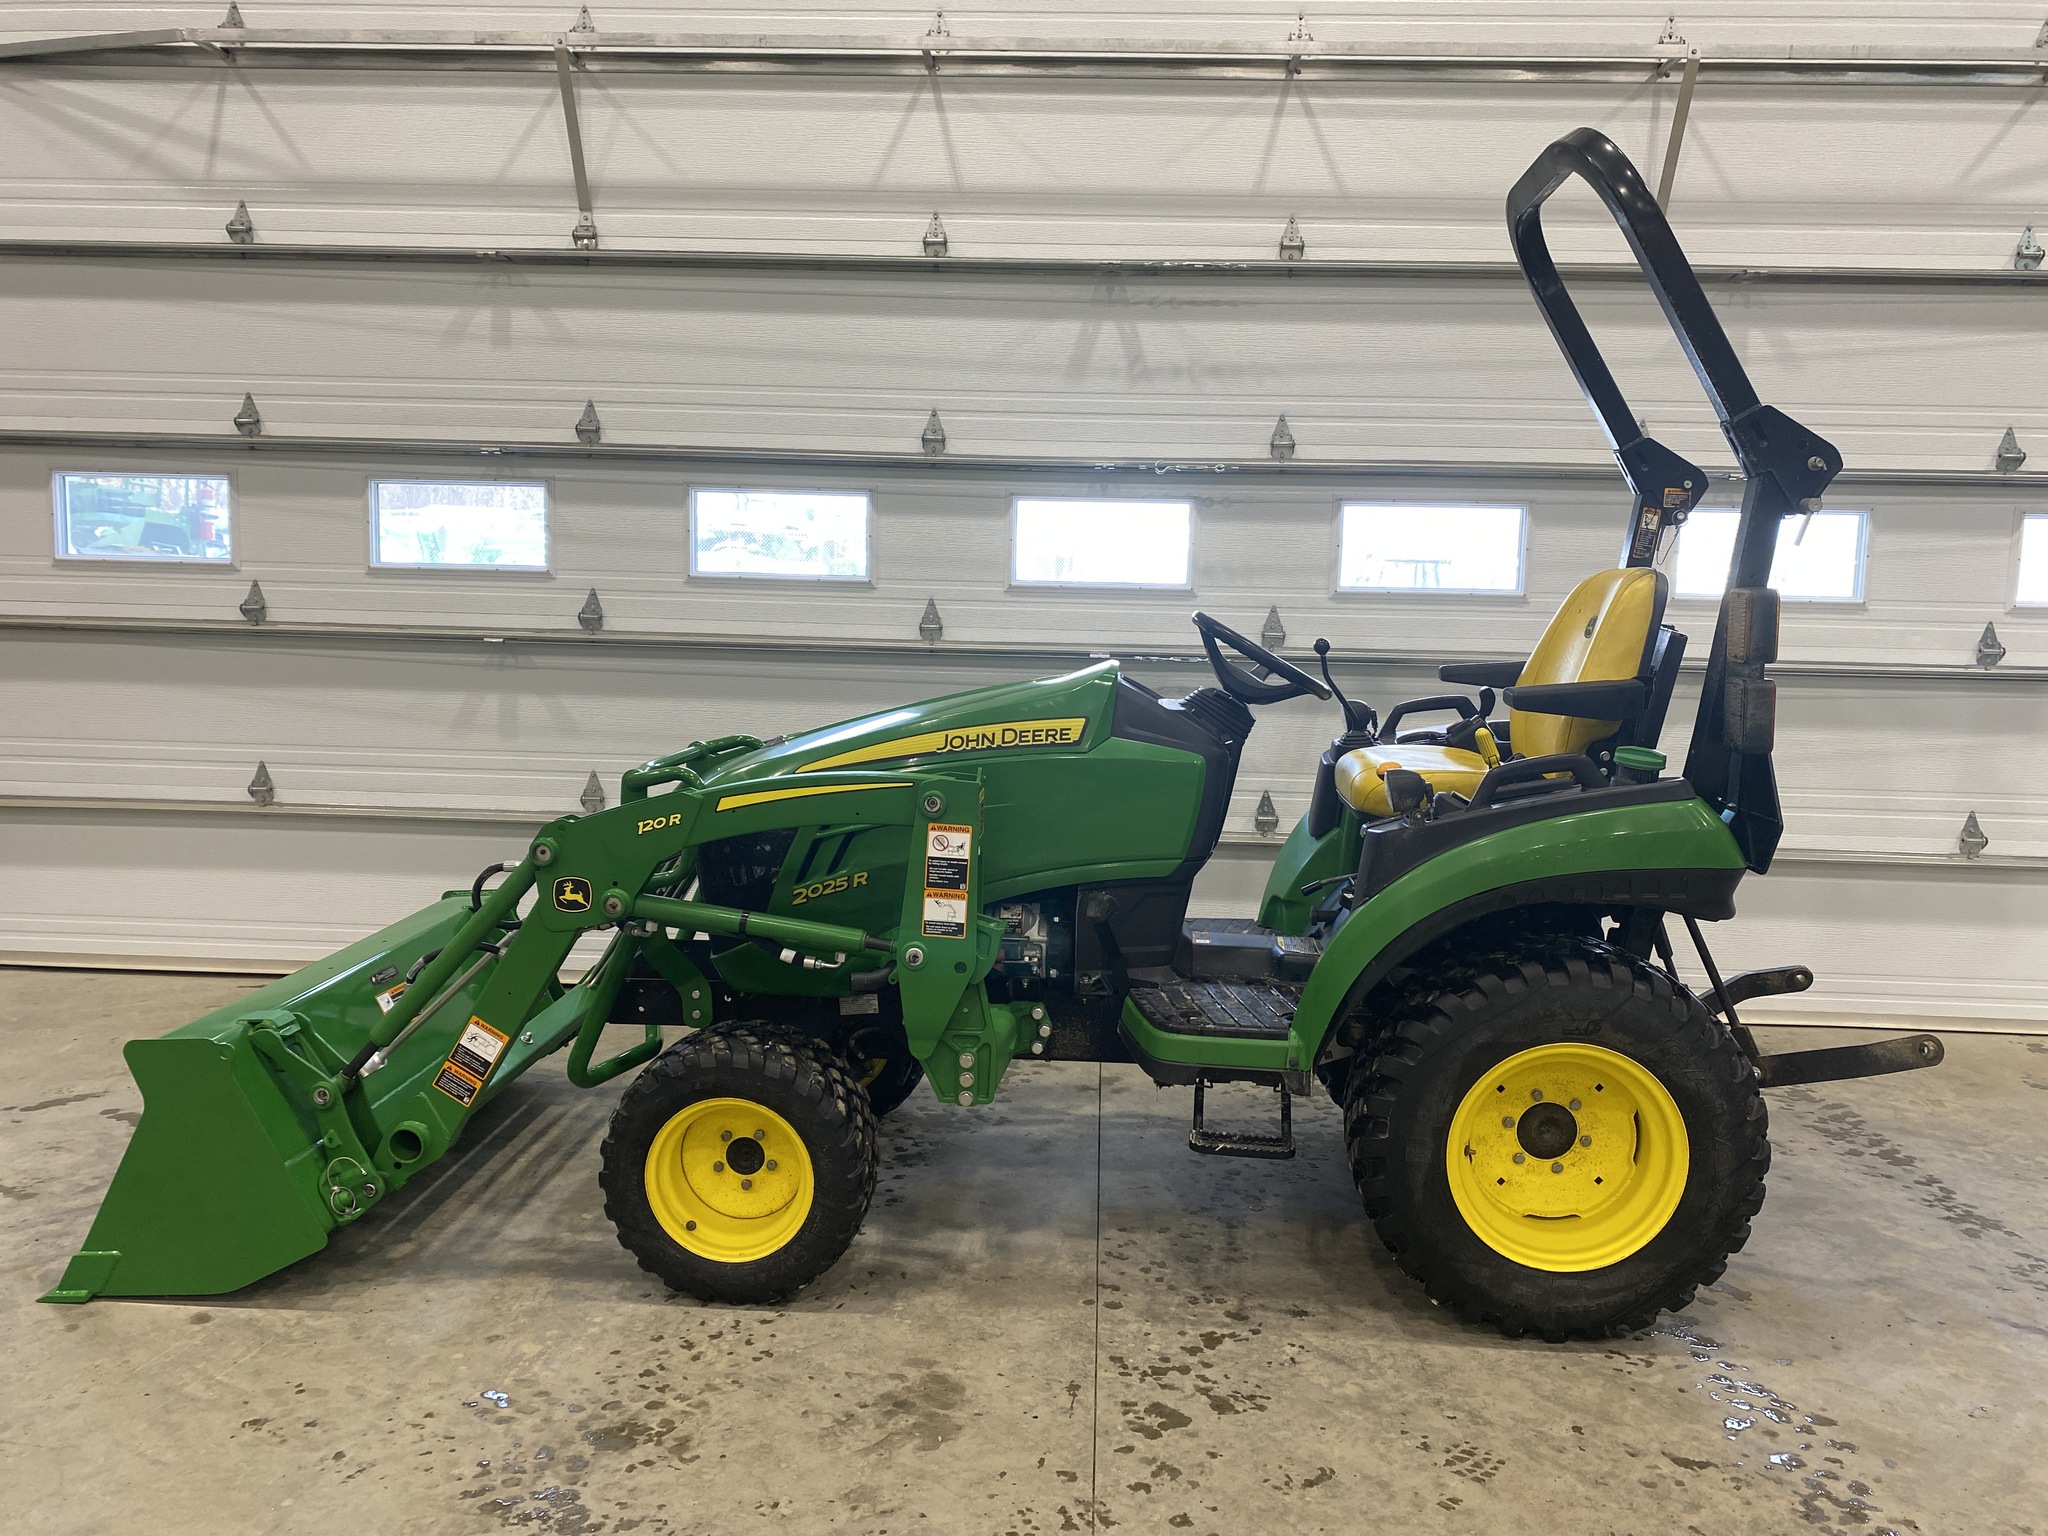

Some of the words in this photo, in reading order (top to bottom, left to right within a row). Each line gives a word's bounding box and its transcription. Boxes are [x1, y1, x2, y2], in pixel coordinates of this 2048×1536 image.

[936, 732, 996, 751] JOHN
[1001, 728, 1072, 746] DEERE
[637, 816, 667, 835] 120
[669, 813, 682, 826] R
[936, 824, 970, 833] WARNING
[792, 876, 848, 905] 2025
[853, 871, 869, 888] R
[932, 891, 966, 900] WARNING
[480, 1023, 504, 1040] WARNING
[453, 1068, 478, 1086] WARNING
